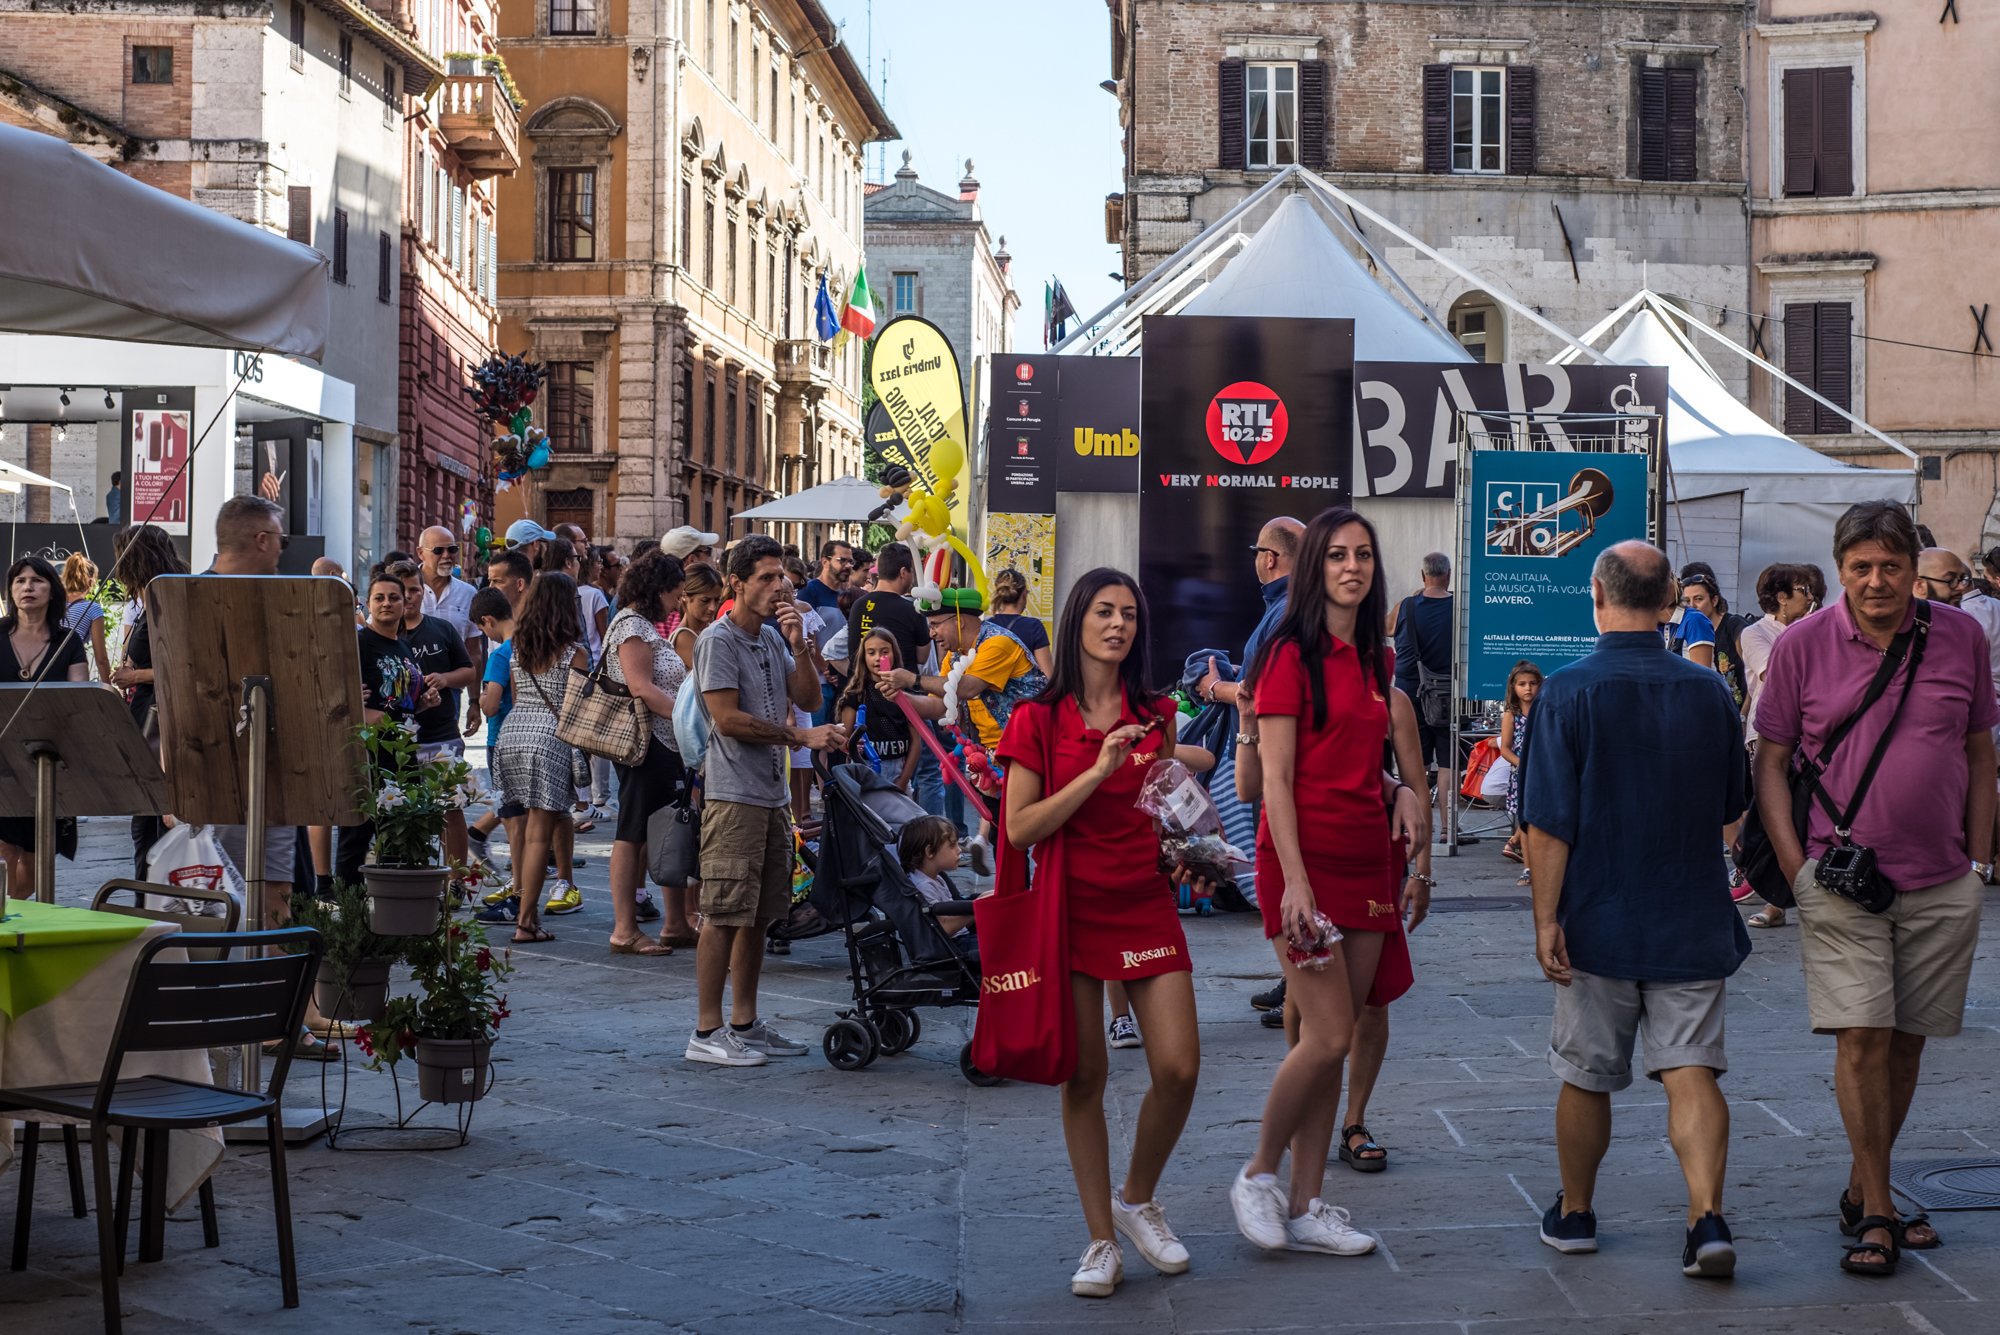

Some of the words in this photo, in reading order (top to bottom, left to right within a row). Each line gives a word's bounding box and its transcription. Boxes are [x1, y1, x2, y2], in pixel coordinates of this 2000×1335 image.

[1222, 403, 1273, 426] RTL
[1222, 427, 1273, 442] 102.5
[1353, 364, 1577, 498] BAR
[1160, 474, 1201, 487] VERY
[1206, 475, 1276, 487] NORMAL
[1281, 476, 1339, 489] PEOPLE
[1043, 542, 1054, 567] MAP
[1485, 572, 1507, 581] CON
[1510, 573, 1551, 583] ALITALIA,
[1042, 576, 1054, 616] LUOGHI
[1485, 584, 1496, 592] LA
[1498, 584, 1536, 593] MUSICA
[1537, 585, 1544, 593] TI
[1547, 586, 1558, 594] FA
[1485, 596, 1534, 604] DAVVERO.
[1121, 945, 1177, 968] Rossana
